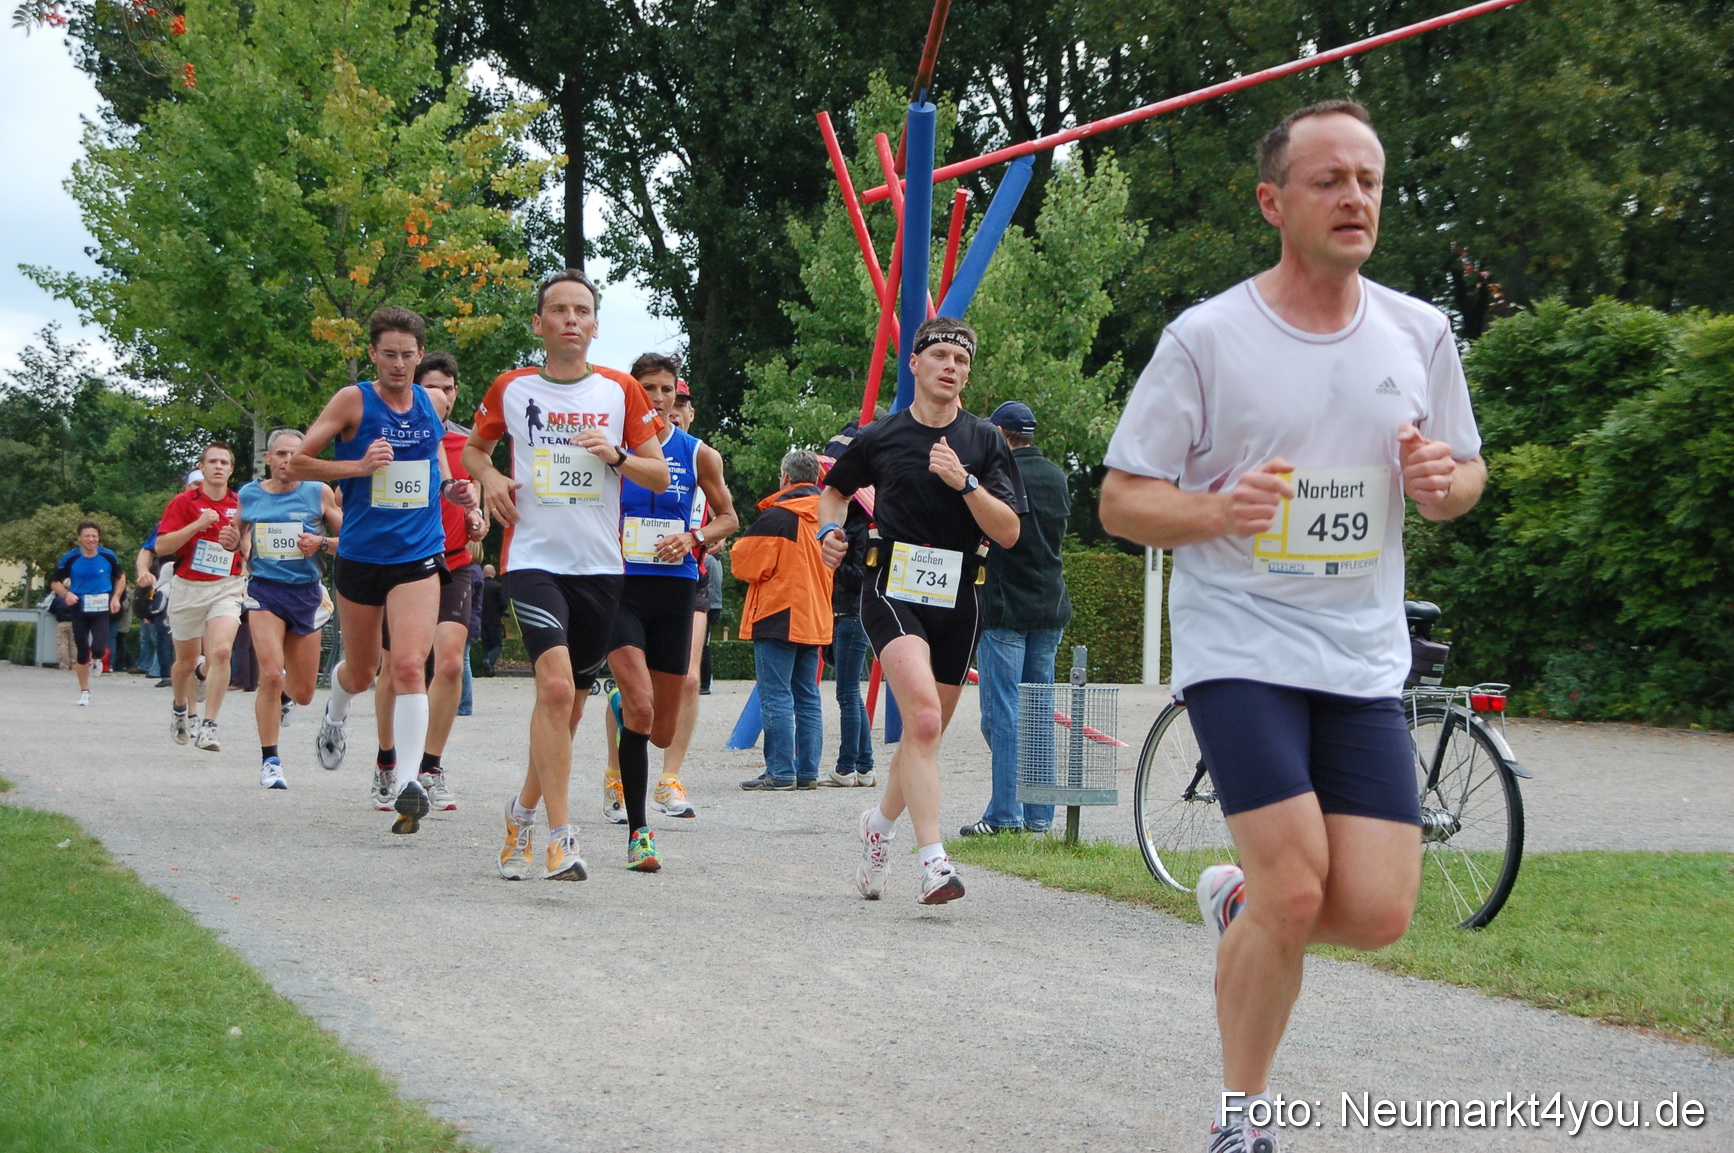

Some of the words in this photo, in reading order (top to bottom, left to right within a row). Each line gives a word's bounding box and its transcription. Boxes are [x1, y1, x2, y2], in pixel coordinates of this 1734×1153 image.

[545, 420, 597, 433] Reisen
[547, 412, 610, 427] MERZ
[381, 427, 431, 439] ELOTEC
[553, 453, 571, 465] Udo
[559, 470, 593, 487] 282
[394, 480, 422, 494] 965
[1297, 478, 1365, 499] Norbert
[641, 518, 670, 529] Kathrin
[1307, 511, 1369, 542] 459
[273, 538, 296, 549] 890
[206, 553, 229, 565] 2018
[911, 551, 944, 566] Jochen
[916, 569, 948, 588] 734
